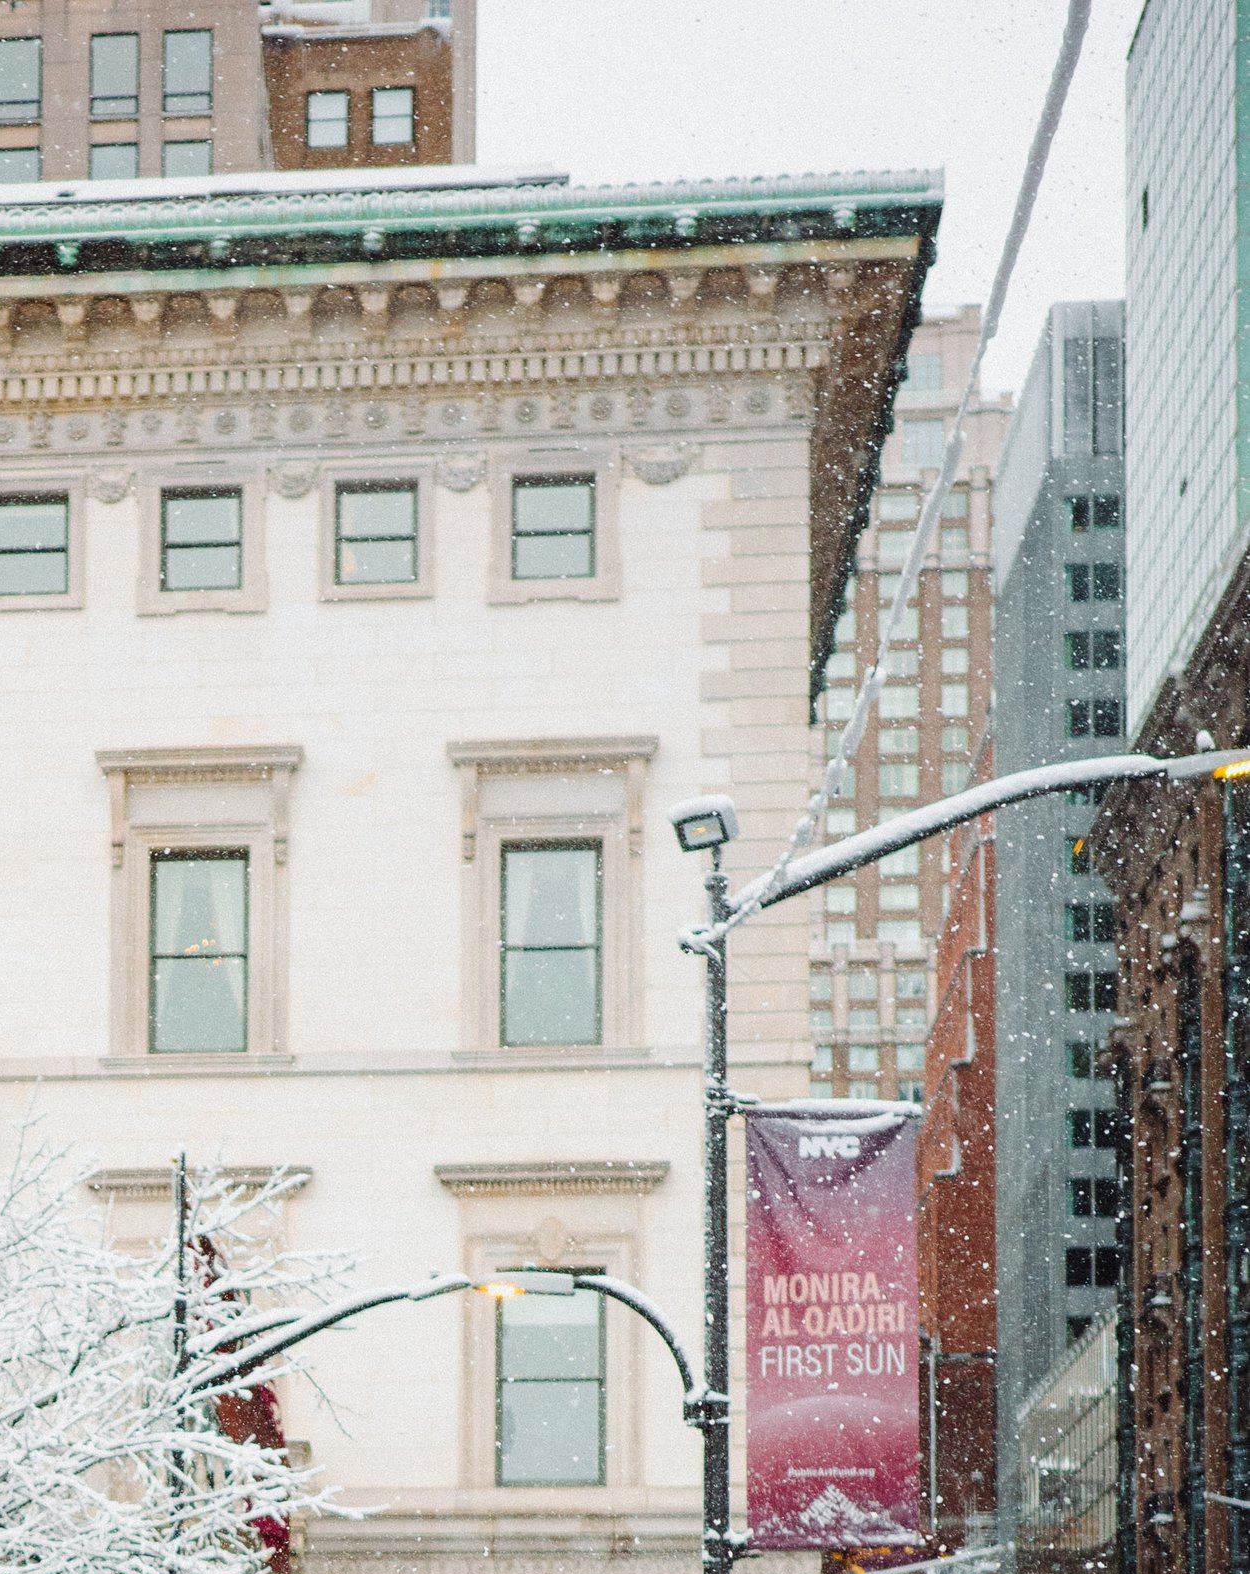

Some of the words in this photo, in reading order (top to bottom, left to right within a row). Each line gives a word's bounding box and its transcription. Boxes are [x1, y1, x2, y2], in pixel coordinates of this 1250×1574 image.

[799, 1135, 861, 1159] NYC
[763, 1272, 881, 1304] MONIRA
[762, 1307, 799, 1337] AL
[804, 1301, 906, 1338] QADIRI
[761, 1343, 839, 1378] FIRST
[846, 1341, 905, 1377] SUN
[787, 1467, 876, 1480] PublicArtFund.org
